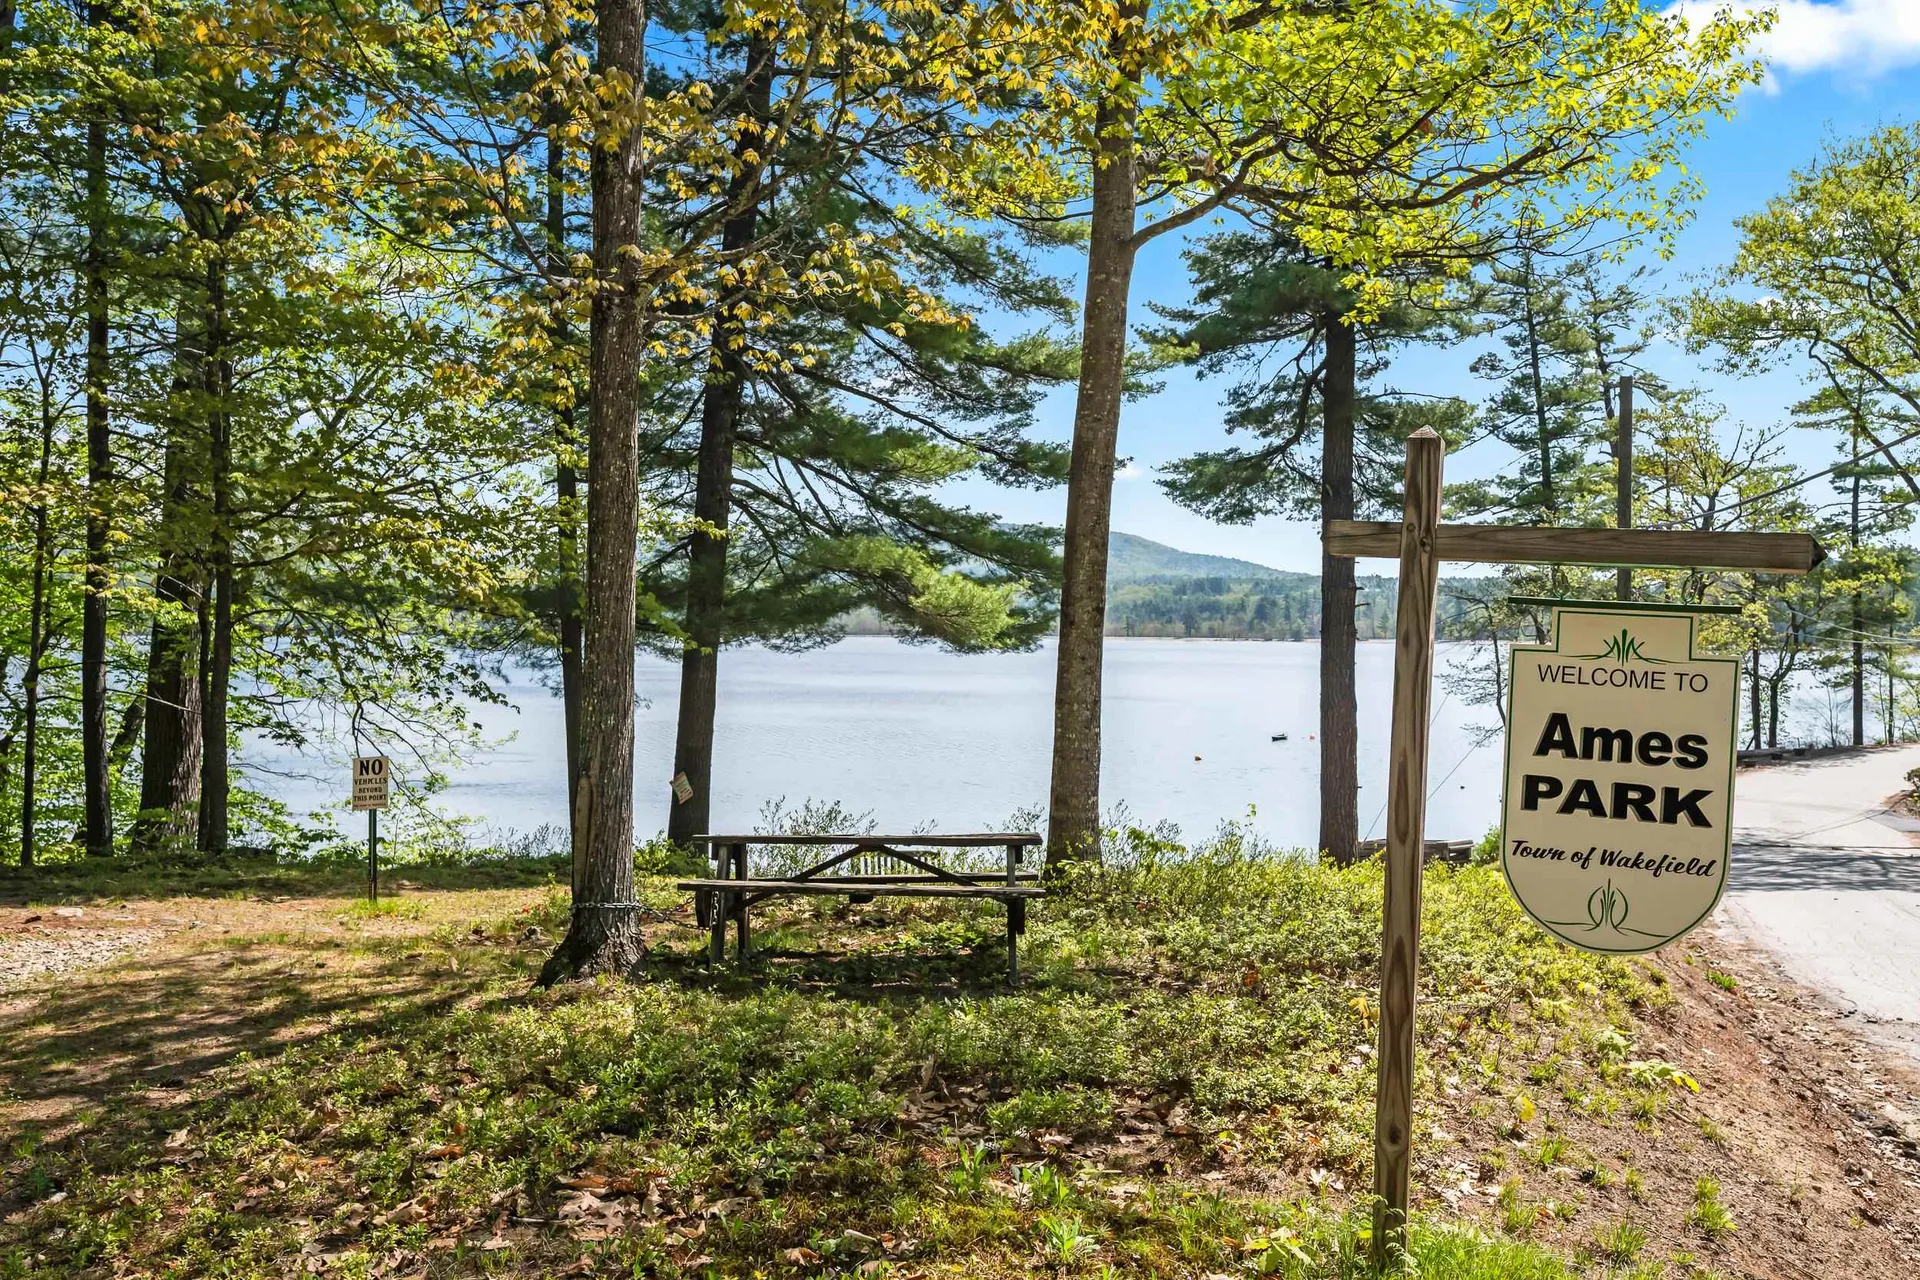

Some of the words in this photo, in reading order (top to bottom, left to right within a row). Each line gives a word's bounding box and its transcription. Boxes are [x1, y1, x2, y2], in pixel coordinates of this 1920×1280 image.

[1537, 664, 1666, 691] WELCOME
[1674, 672, 1708, 693] TO
[1532, 712, 1709, 770] Ames
[354, 777, 387, 786] VEHICLES
[359, 759, 383, 776] NO
[1520, 774, 1714, 829] PARK
[1511, 840, 1567, 861] Town
[1571, 847, 1597, 870] of
[1599, 849, 1716, 878] Wakefield
